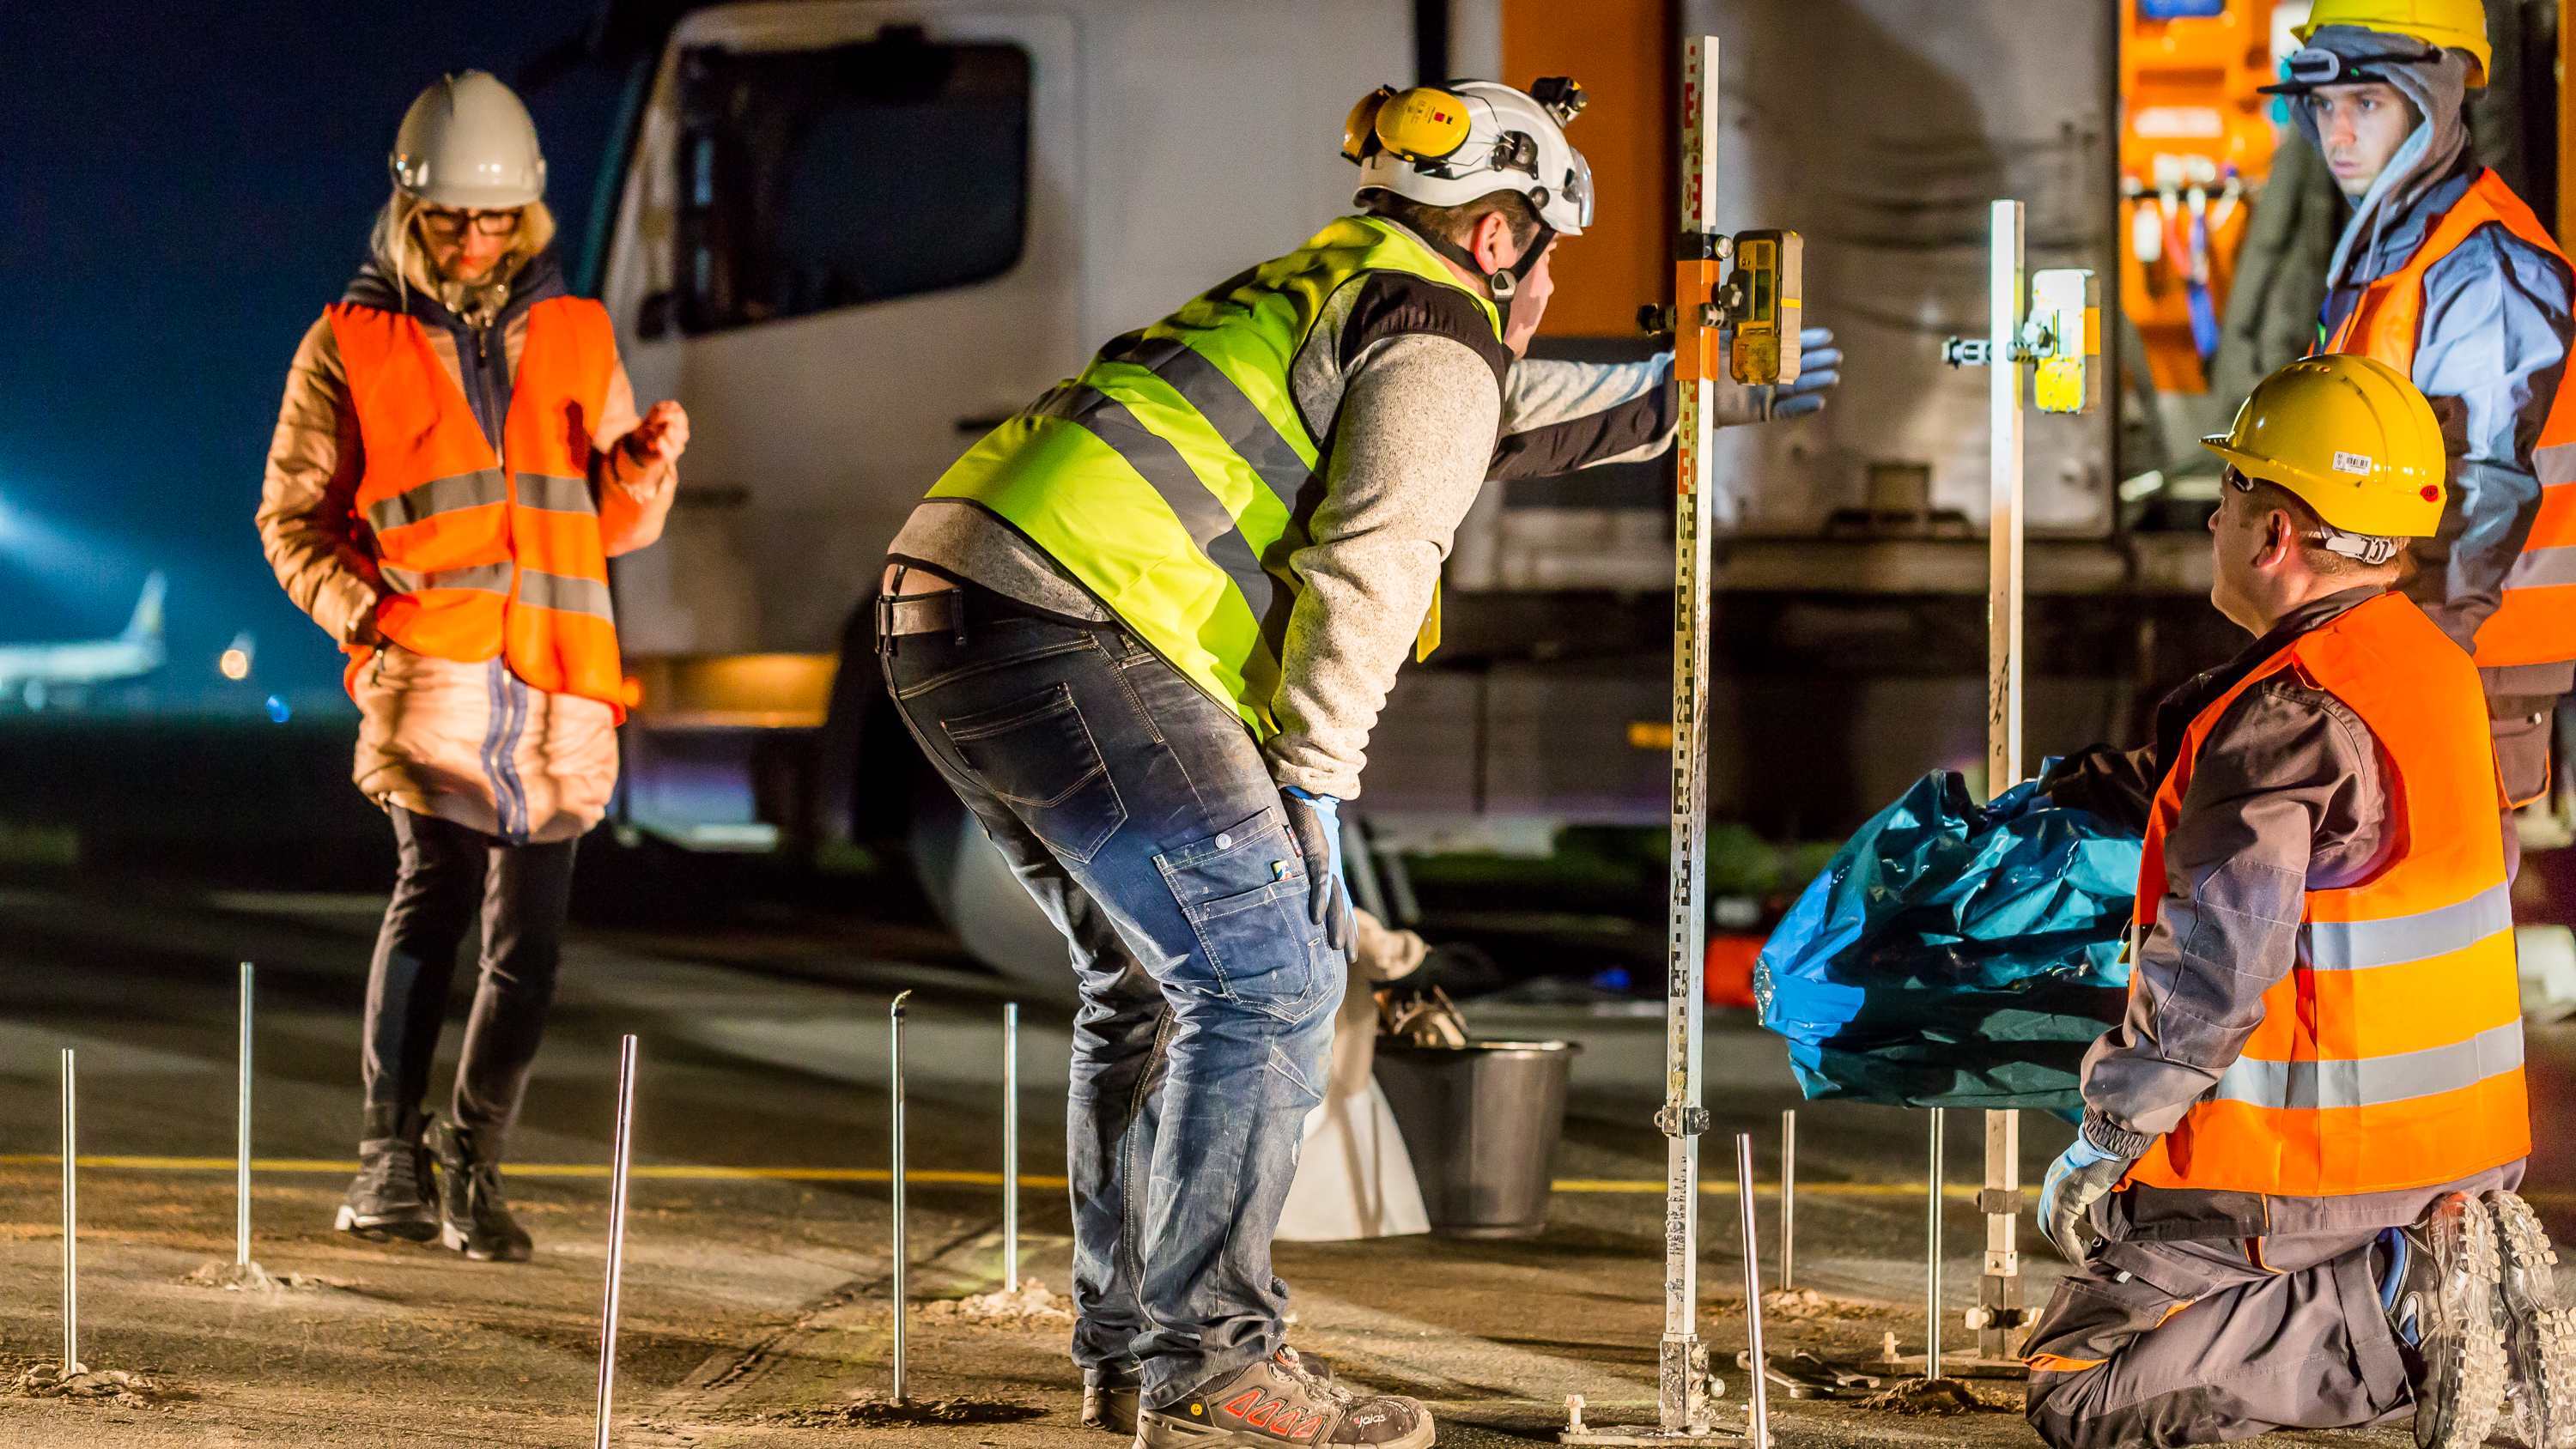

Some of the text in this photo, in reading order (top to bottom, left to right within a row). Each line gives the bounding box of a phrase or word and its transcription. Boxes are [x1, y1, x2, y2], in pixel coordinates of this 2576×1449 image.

[1690, 458, 1696, 485] 0
[1680, 512, 1686, 540] 0
[1676, 694, 1683, 724] 2
[1685, 786, 1691, 815] 3
